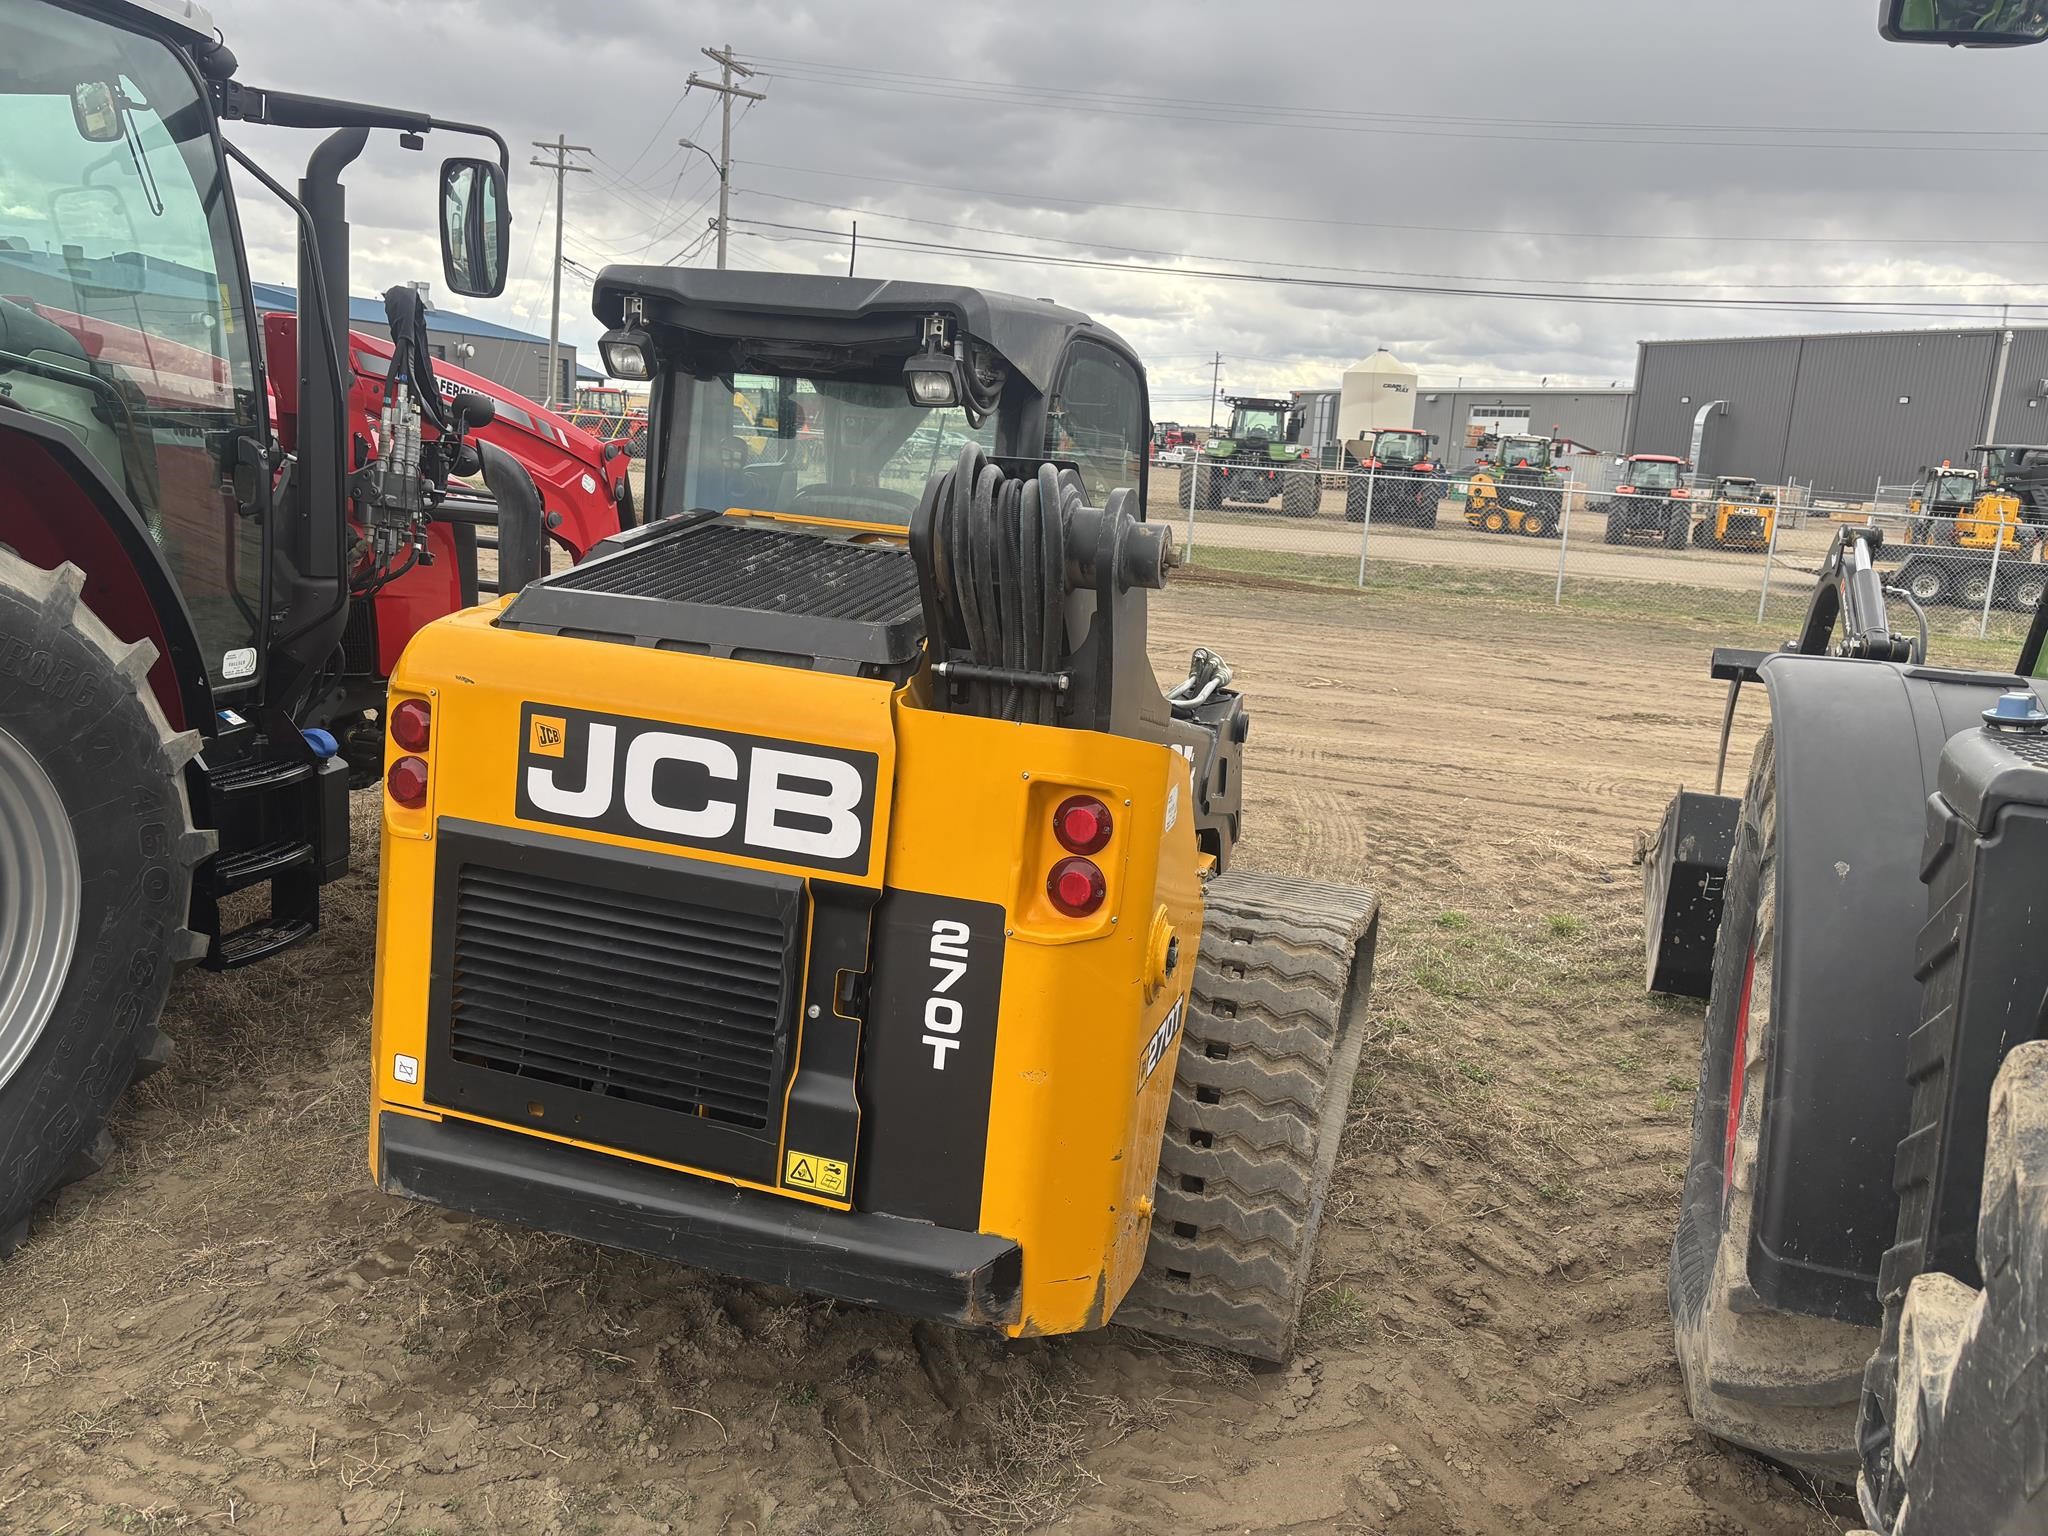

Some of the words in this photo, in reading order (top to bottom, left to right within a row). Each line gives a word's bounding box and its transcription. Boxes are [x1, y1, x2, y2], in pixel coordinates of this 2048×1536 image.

[1508, 495, 1538, 507] ROBOT
[1734, 507, 1758, 515] JCB
[539, 725, 560, 744] JCB
[527, 722, 863, 860] JCB
[922, 919, 971, 1071] 270T
[1146, 993, 1183, 1077] 270T
